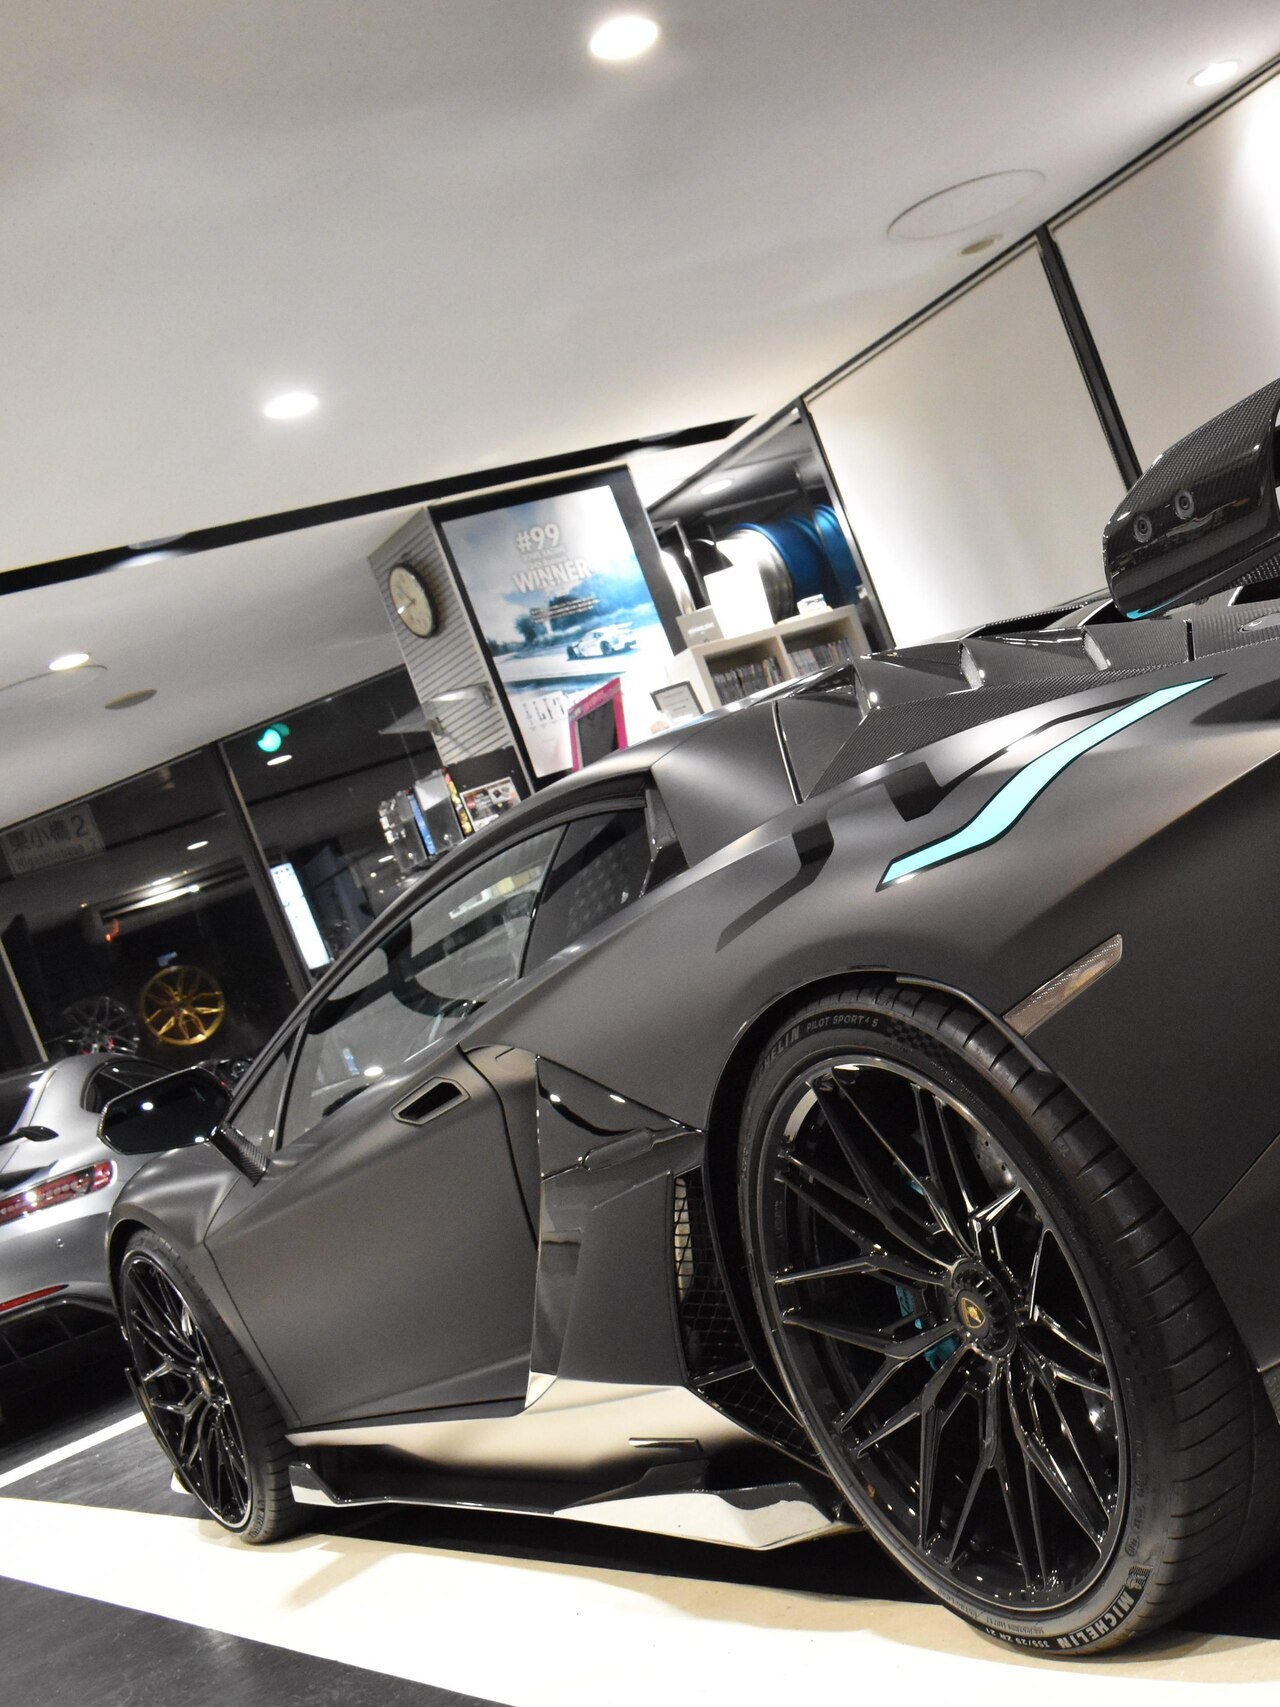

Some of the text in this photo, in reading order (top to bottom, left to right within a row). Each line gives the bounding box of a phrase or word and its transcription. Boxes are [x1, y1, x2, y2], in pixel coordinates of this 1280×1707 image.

[516, 523, 560, 552] #99
[512, 558, 592, 593] WINNER
[806, 1016, 829, 1033] PILOT
[1056, 1590, 1135, 1649] MICHELIN
[1015, 1637, 1050, 1648] 355/25
